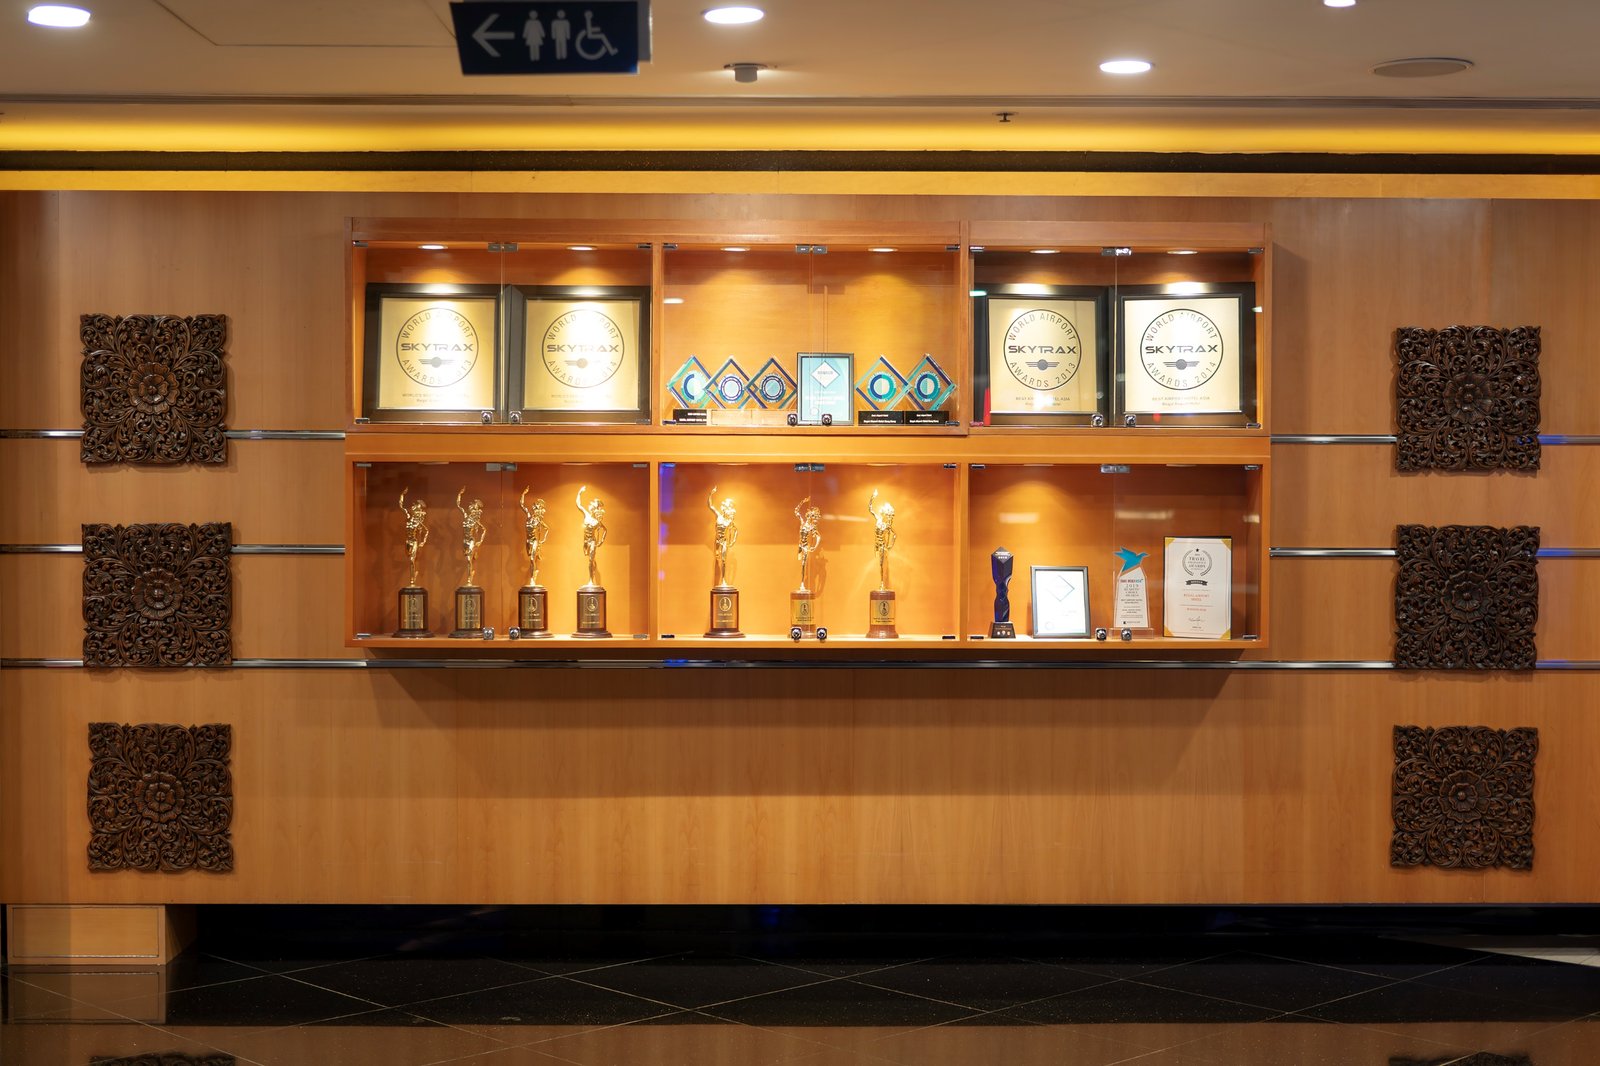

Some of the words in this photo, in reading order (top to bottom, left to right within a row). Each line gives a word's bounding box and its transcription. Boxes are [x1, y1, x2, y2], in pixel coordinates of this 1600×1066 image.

[401, 312, 431, 339] WORLD
[547, 314, 577, 340] WORLD
[1008, 314, 1035, 341] WORLD
[1040, 312, 1077, 340] AIRPORT
[1145, 313, 1175, 342] WORLD
[400, 343, 474, 352] SKYTRAX
[1008, 345, 1078, 355] SKYTRAX
[1145, 344, 1219, 354] SKYTRAX
[547, 360, 584, 385] AWARD
[1009, 361, 1049, 388] AWARDS
[1055, 362, 1076, 384] 2013
[1147, 361, 1188, 388] AWARDS
[1194, 361, 1217, 384] 2014
